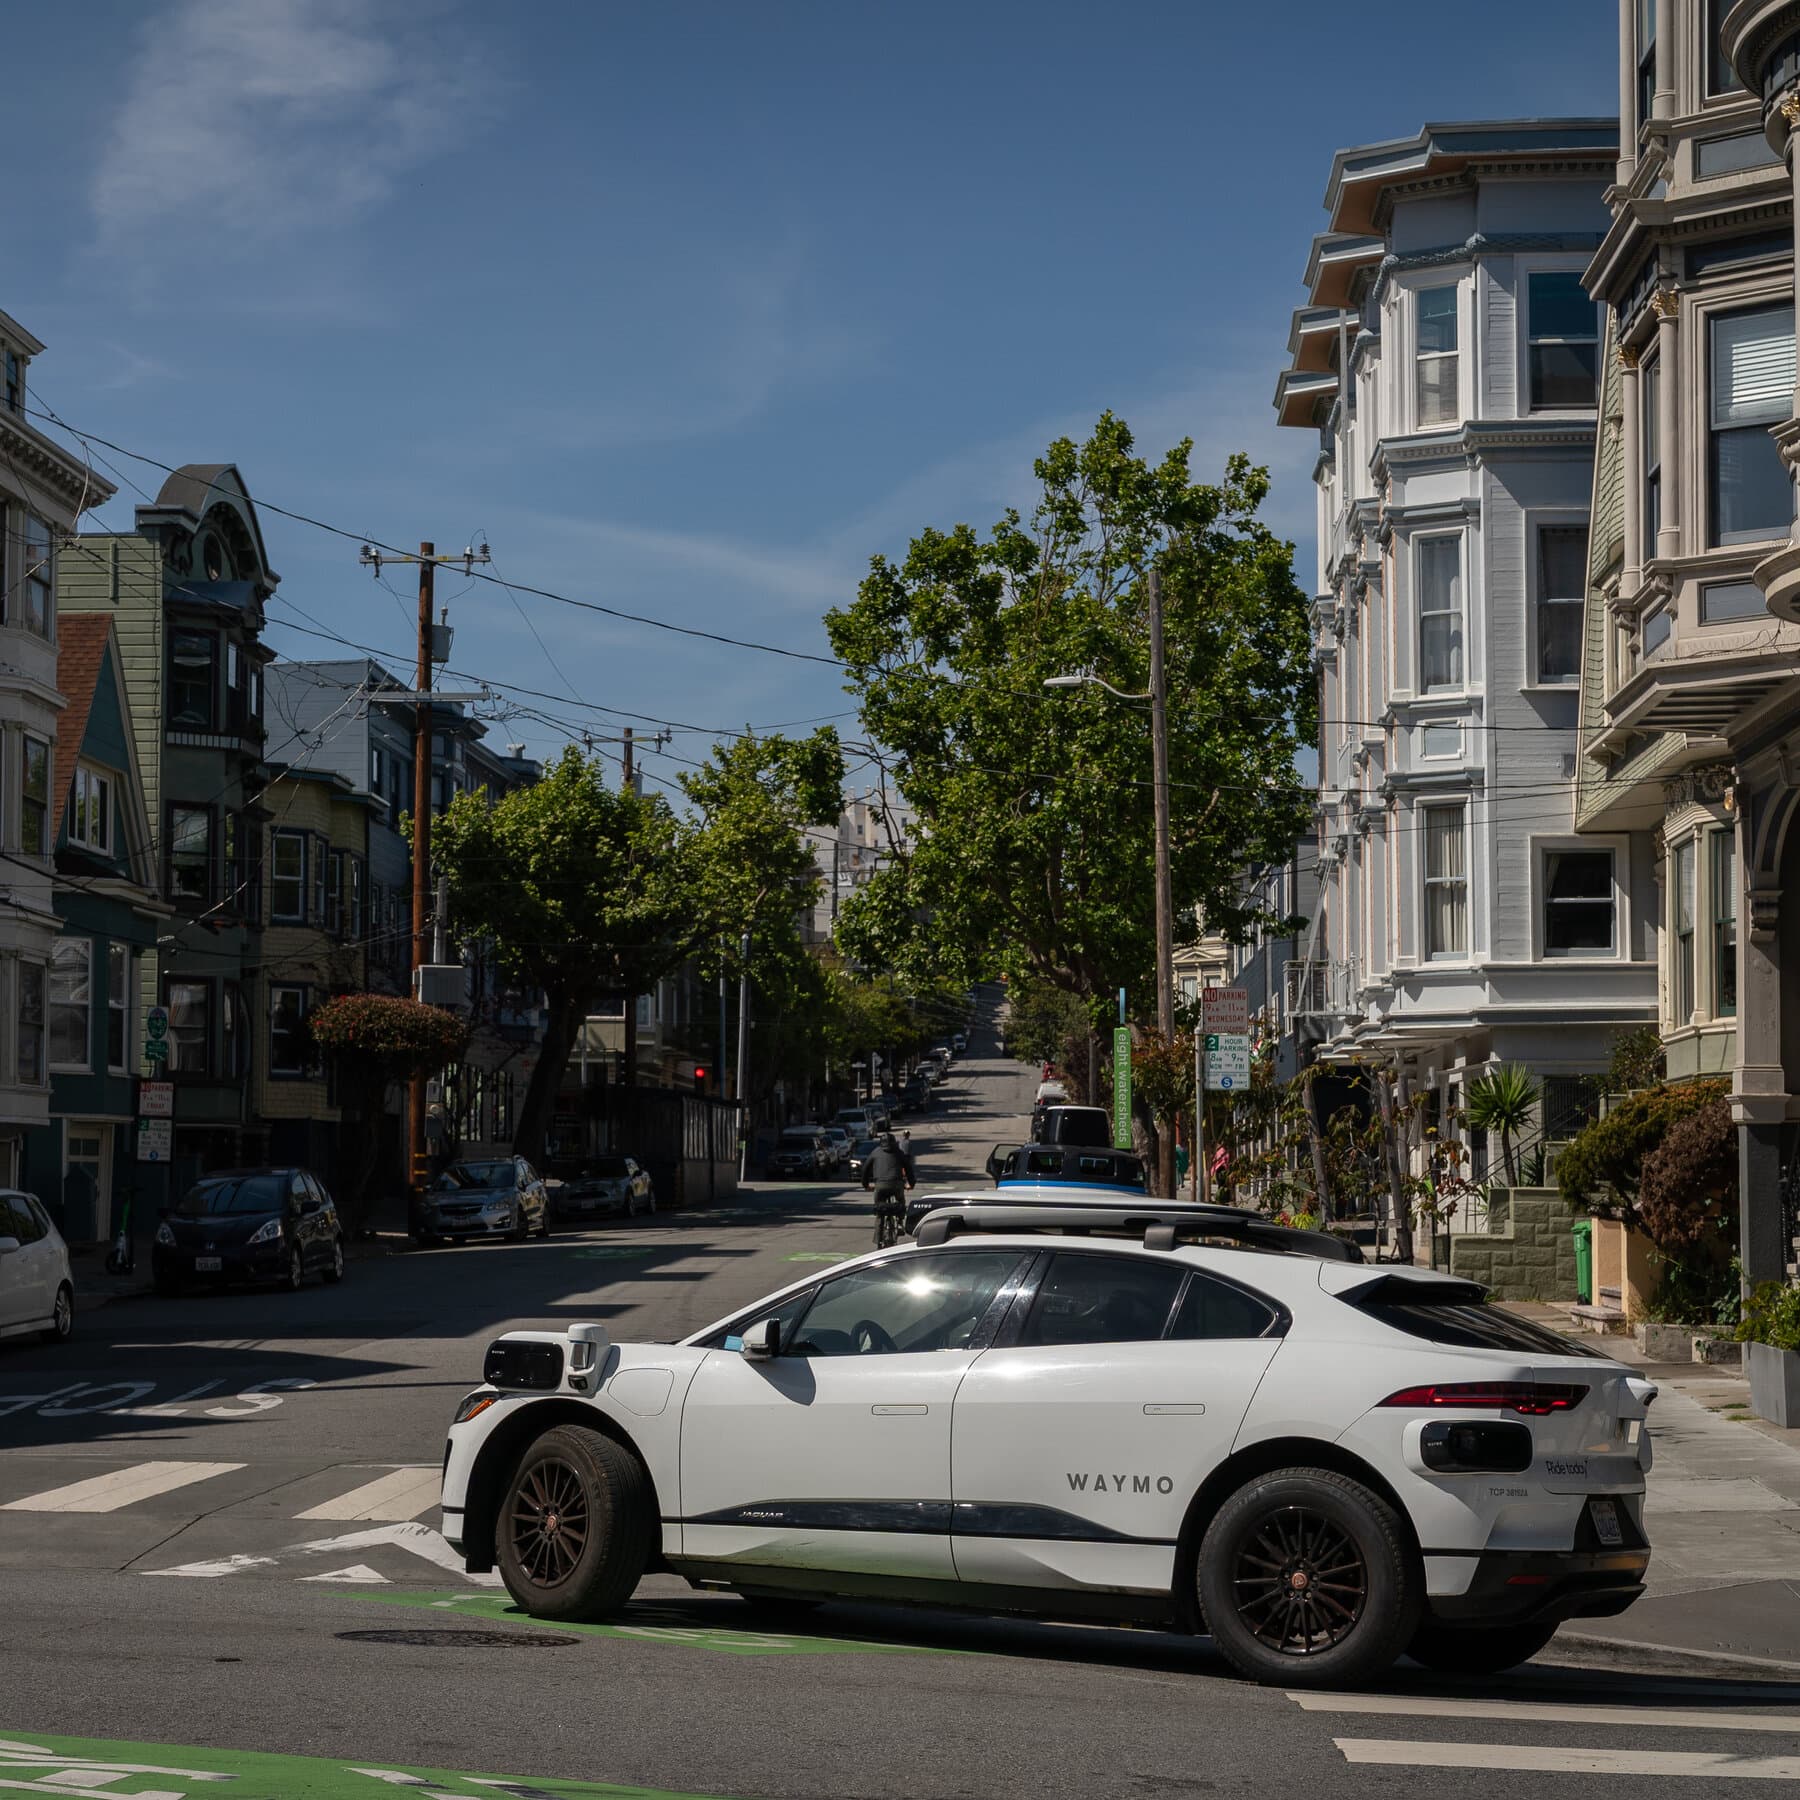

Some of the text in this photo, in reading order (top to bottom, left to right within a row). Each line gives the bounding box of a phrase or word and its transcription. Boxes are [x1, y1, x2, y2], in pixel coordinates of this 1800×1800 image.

[1204, 990, 1246, 1001] NO PARKING
[1208, 1037, 1216, 1049] 2
[1117, 1034, 1128, 1142] eight watersheds
[1546, 1460, 1566, 1475] Ride
[1066, 1473, 1174, 1494] WAYMO
[1489, 1488, 1505, 1496] TCP
